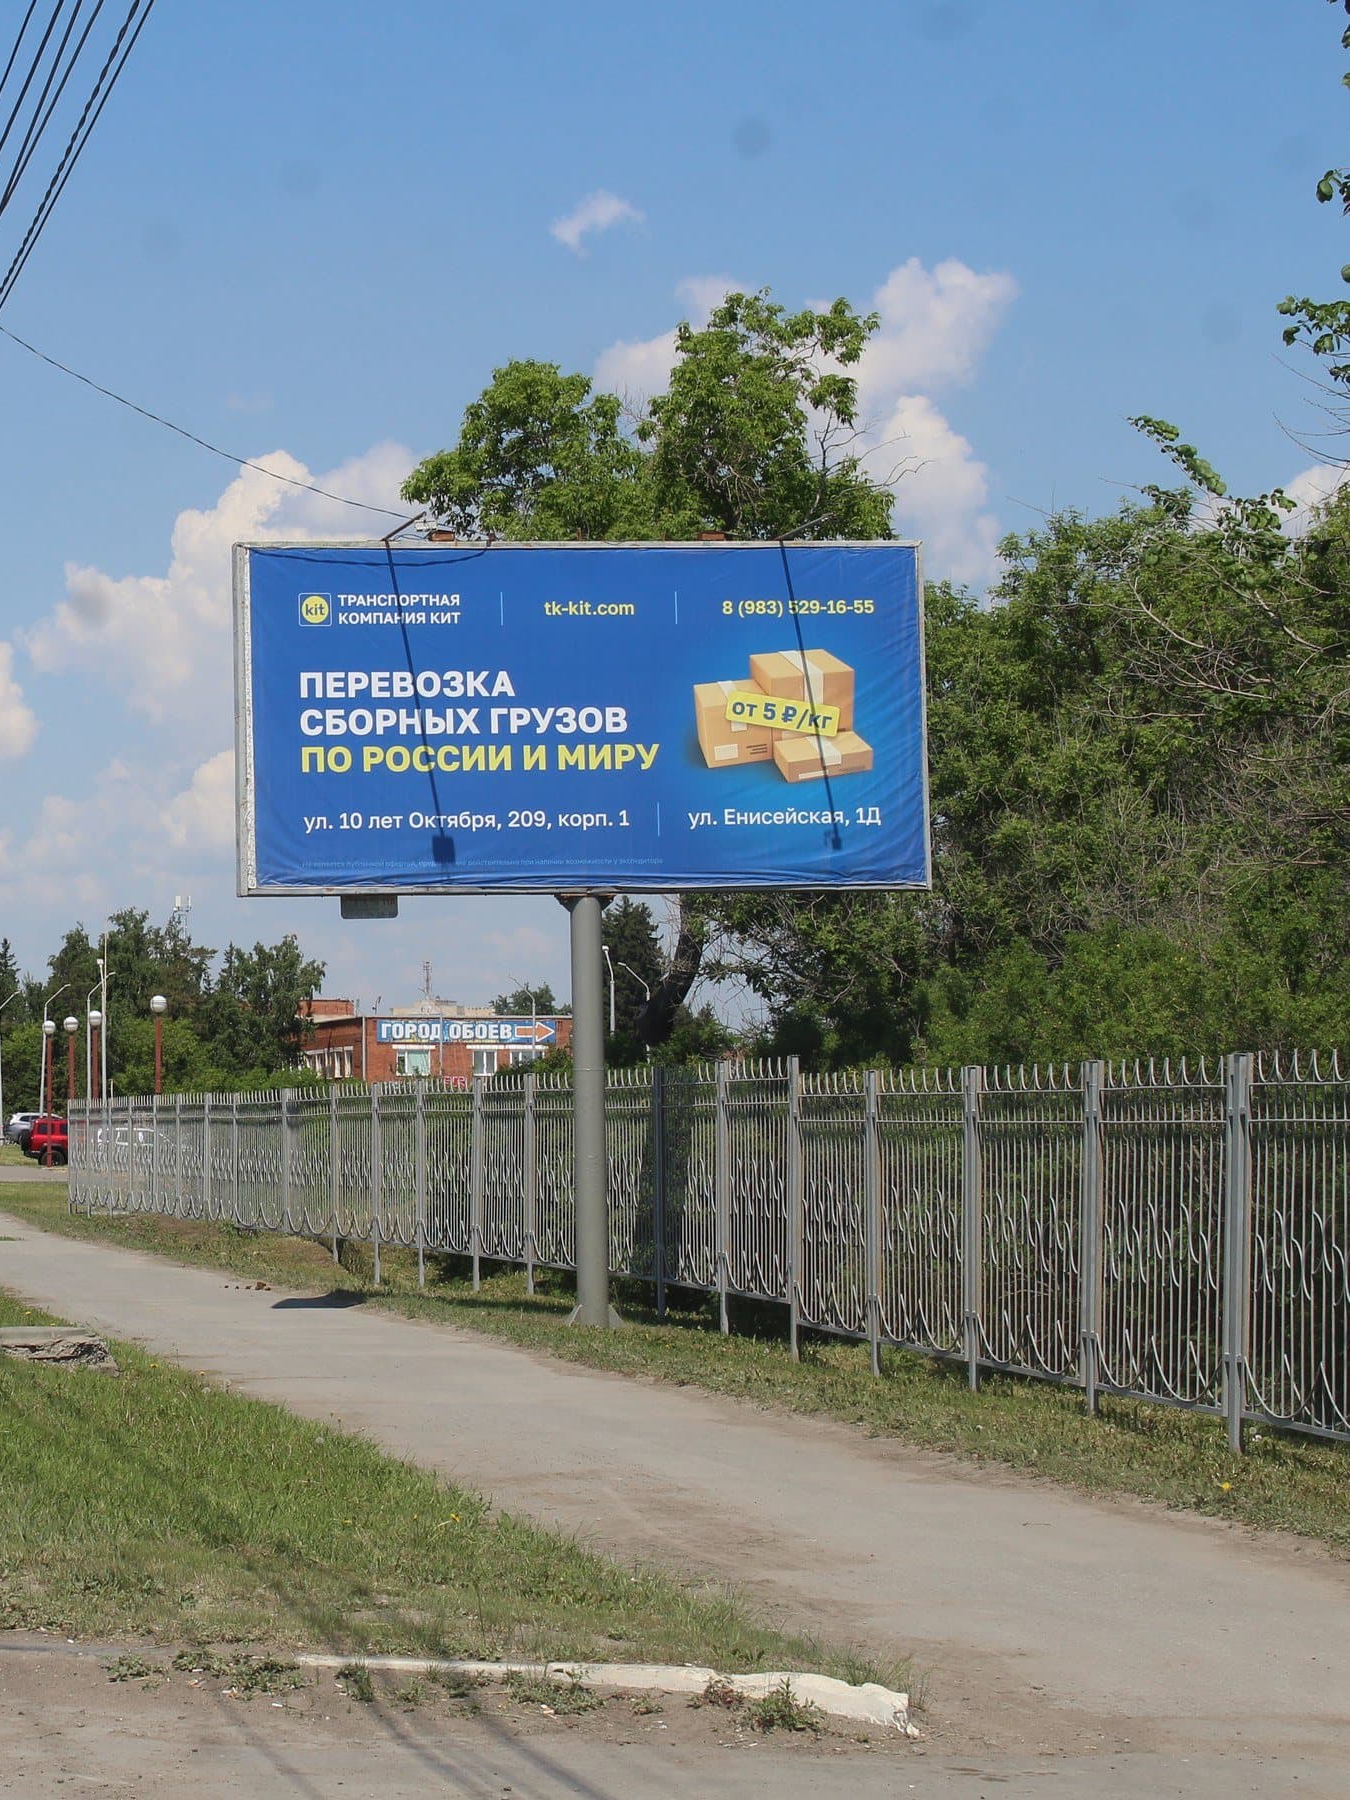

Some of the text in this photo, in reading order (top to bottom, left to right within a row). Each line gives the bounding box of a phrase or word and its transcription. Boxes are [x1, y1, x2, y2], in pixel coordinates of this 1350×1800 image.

[305, 603, 325, 616] kit
[337, 594, 460, 607] ТРАНСПОРТНАЯ
[544, 601, 635, 616] tk-kit.com
[722, 600, 875, 618] 8 (983) 529-16-55
[338, 612, 461, 625] КОМПАНИЯ КИТ
[300, 671, 516, 698] ПЕРЕВОЗКА
[732, 702, 757, 717] от
[763, 702, 776, 720] 5
[300, 707, 628, 736] СБОРНЫХ ГРУЗОВ
[301, 743, 659, 773] ПО РОССИИ И МИРУ
[303, 809, 630, 834] ул. 10 лет Октября, 209, корп. 1
[688, 806, 881, 829] ул. Енисейская, 1Д
[381, 1023, 512, 1040] ГОРОД ОБОЕВ
